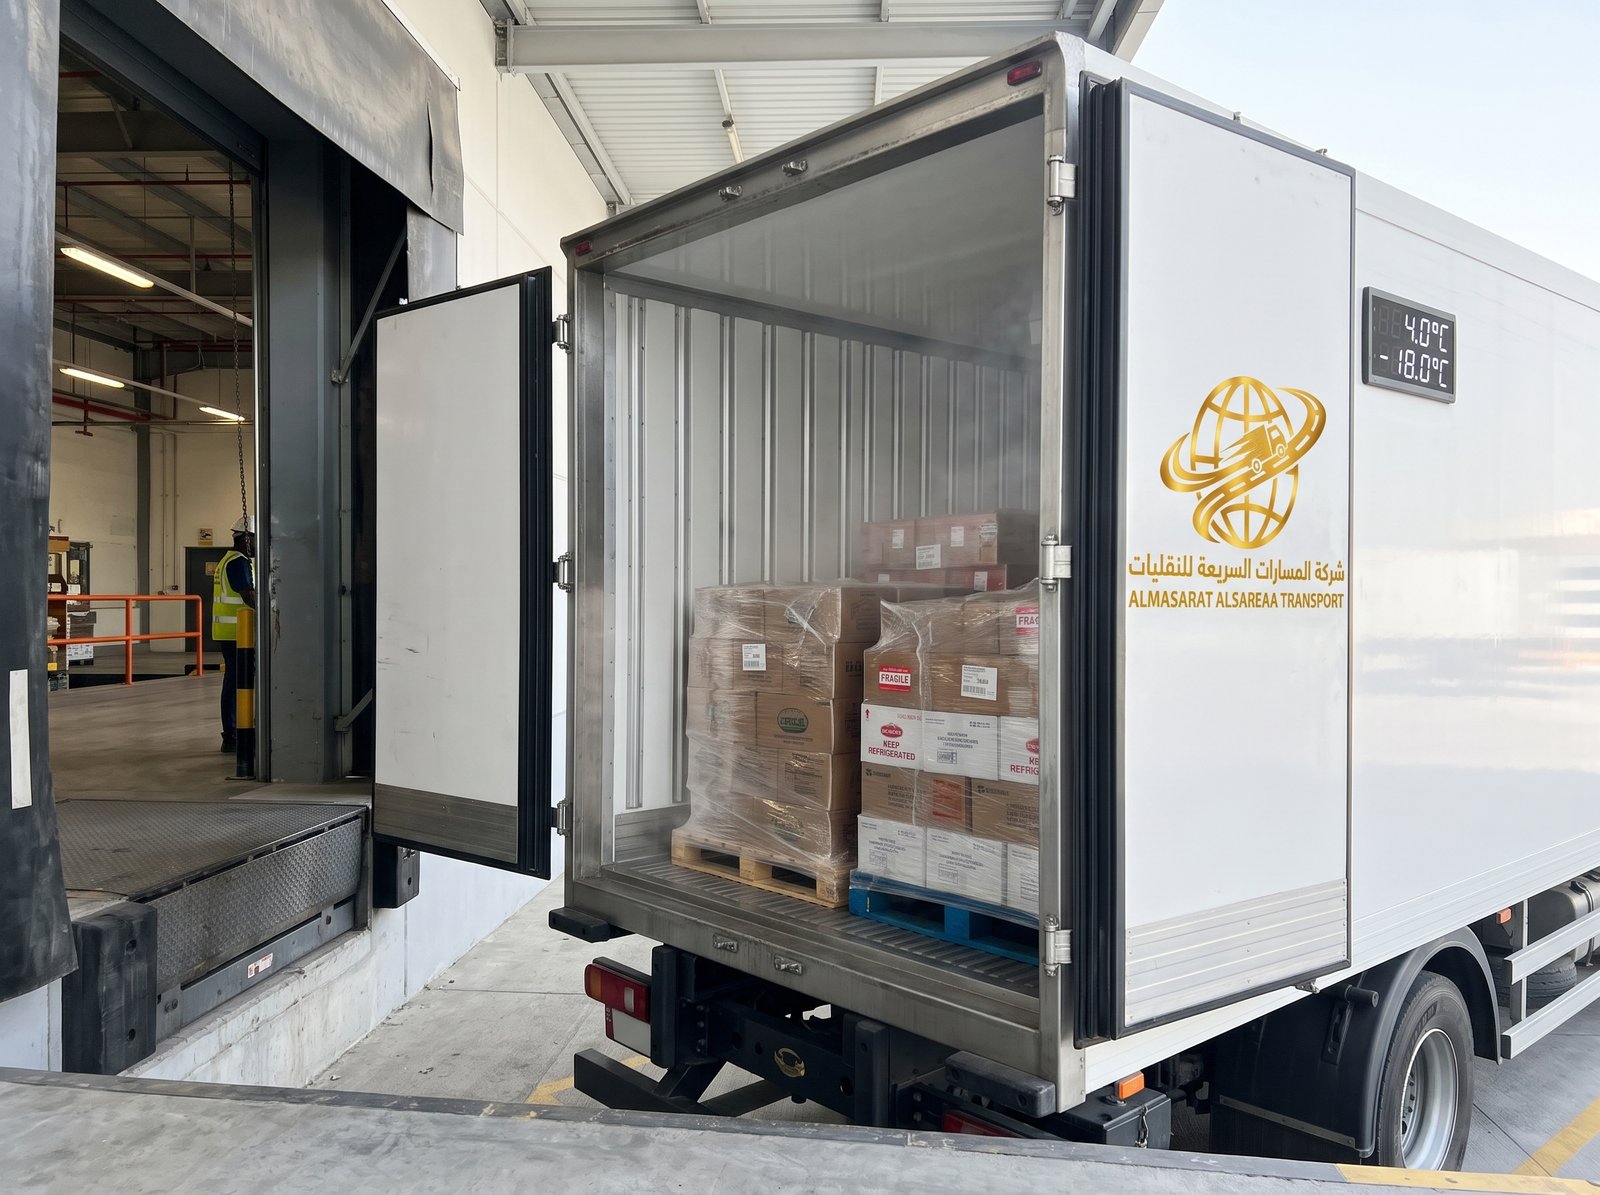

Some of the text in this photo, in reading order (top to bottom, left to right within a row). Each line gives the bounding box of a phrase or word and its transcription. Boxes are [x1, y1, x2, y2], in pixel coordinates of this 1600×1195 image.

[1404, 314, 1449, 353] 4.0°C
[1128, 553, 1345, 586] شركة المسارات السريعة للنقليات
[1128, 590, 1344, 608] ALMASARAT ALSAREAA TRANSPORT
[880, 673, 909, 684] FRAGILE
[883, 740, 900, 749] KEEP
[868, 746, 916, 761] REFRIGERATED
